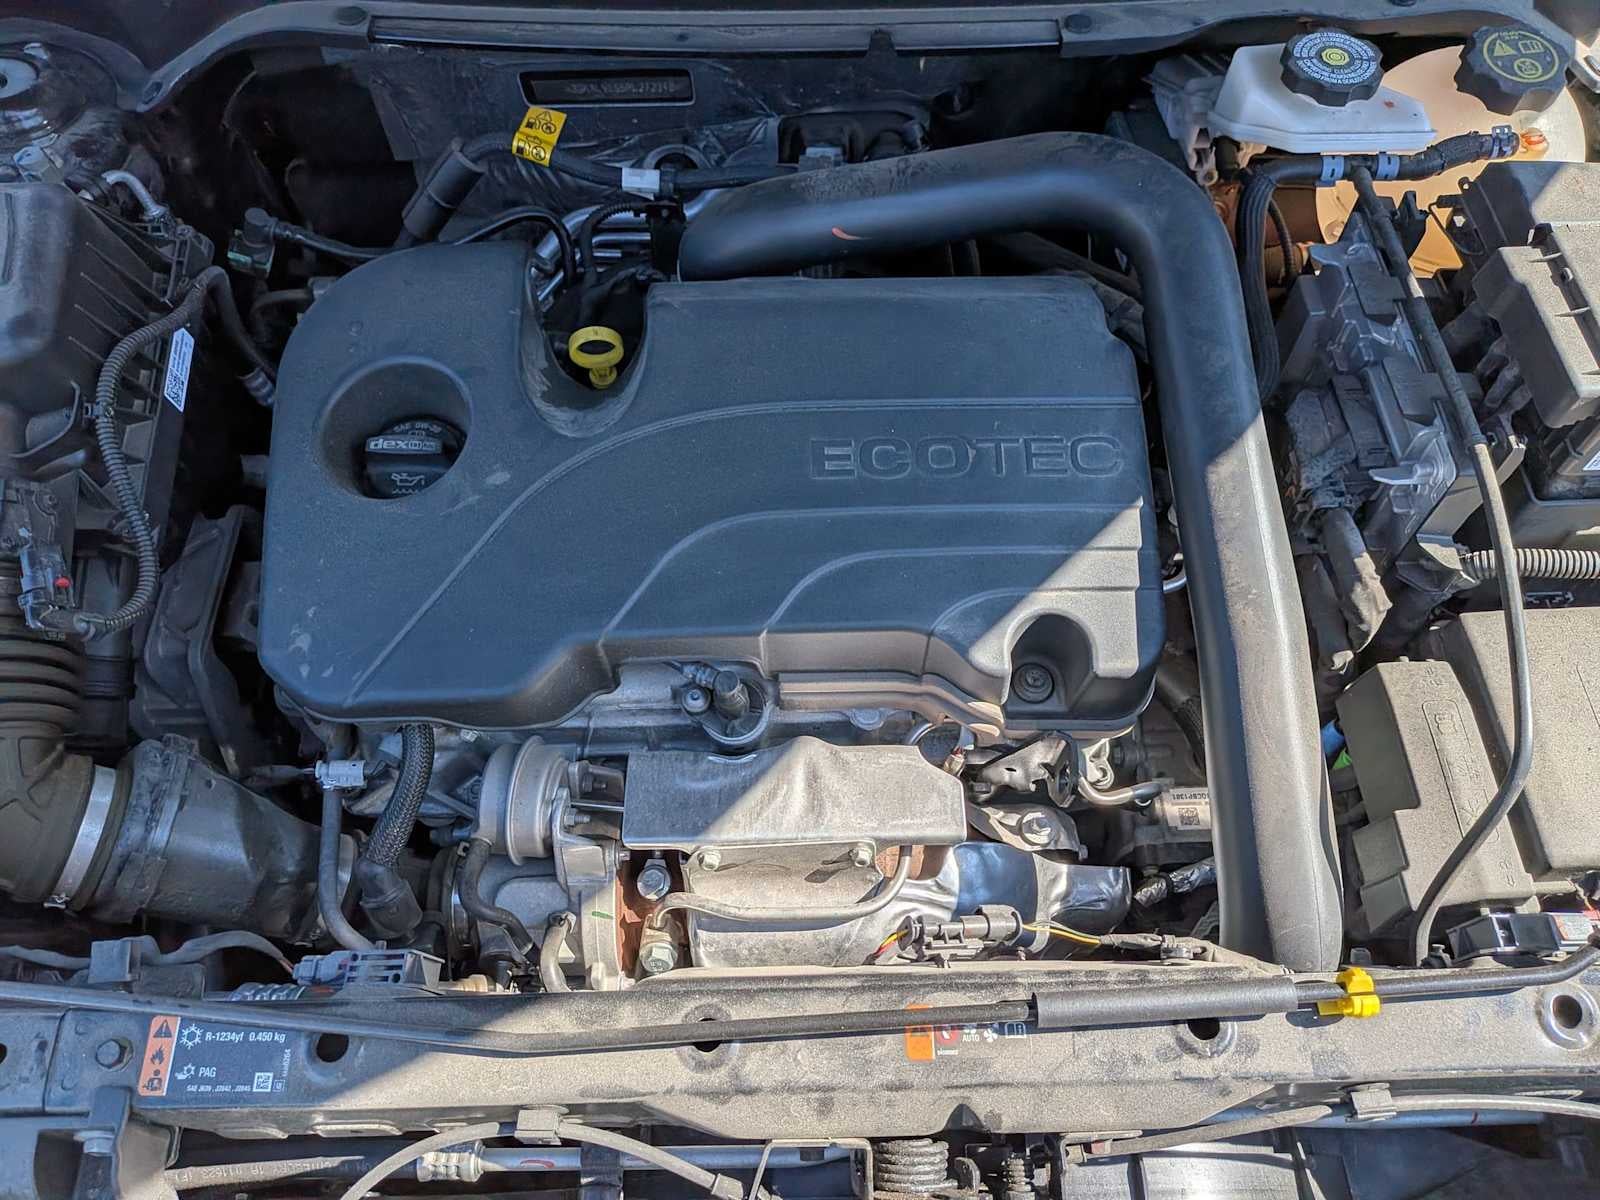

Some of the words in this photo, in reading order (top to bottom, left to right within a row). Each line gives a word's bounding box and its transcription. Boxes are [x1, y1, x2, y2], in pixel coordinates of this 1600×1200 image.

[809, 434, 1122, 480] ECOTEC
[205, 1031, 244, 1043] R-1234yf
[250, 1031, 273, 1042] 0.450
[274, 1032, 286, 1043] kg
[962, 1034, 980, 1042] AUTO
[199, 1066, 216, 1078] PAG
